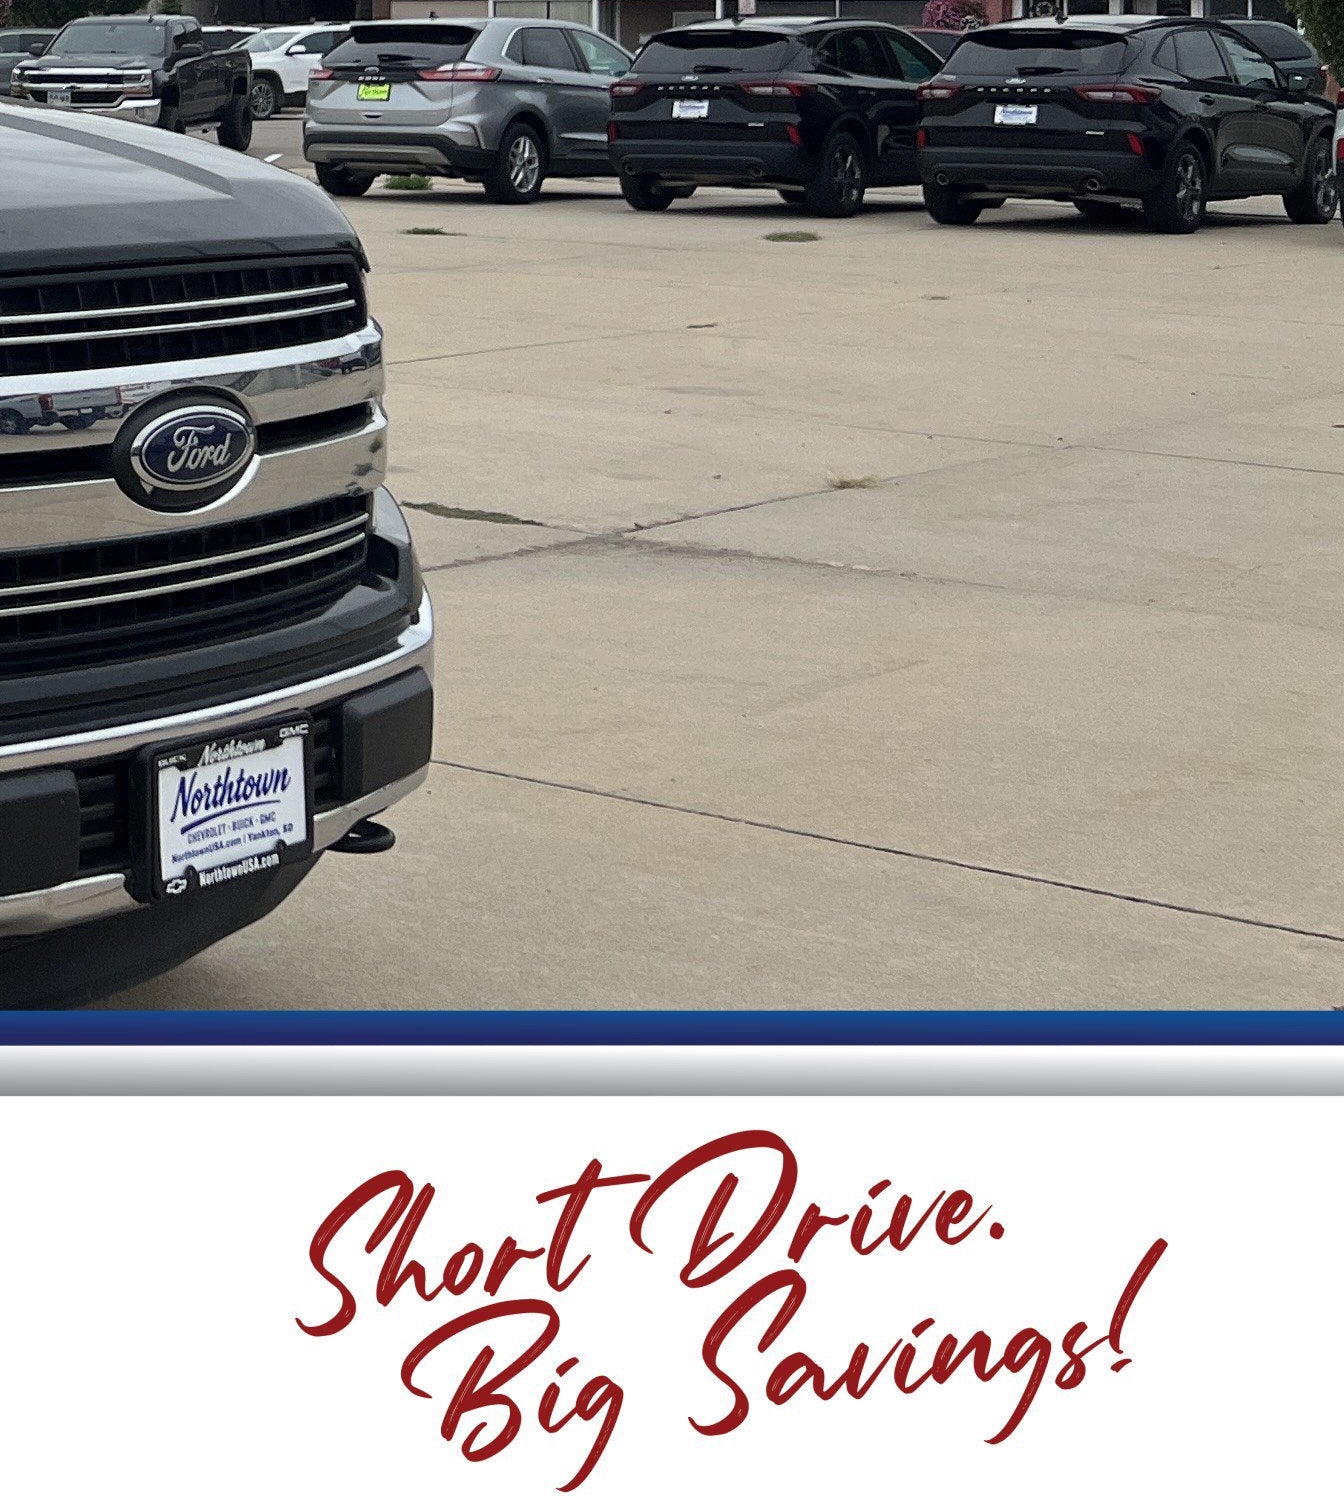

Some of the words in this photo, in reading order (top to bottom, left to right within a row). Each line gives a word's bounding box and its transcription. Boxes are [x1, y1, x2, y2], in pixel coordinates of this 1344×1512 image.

[167, 425, 232, 473] Ford
[279, 724, 310, 738] GMC
[170, 766, 291, 823] Northtown
[199, 853, 280, 887] NorthtownUSA.com
